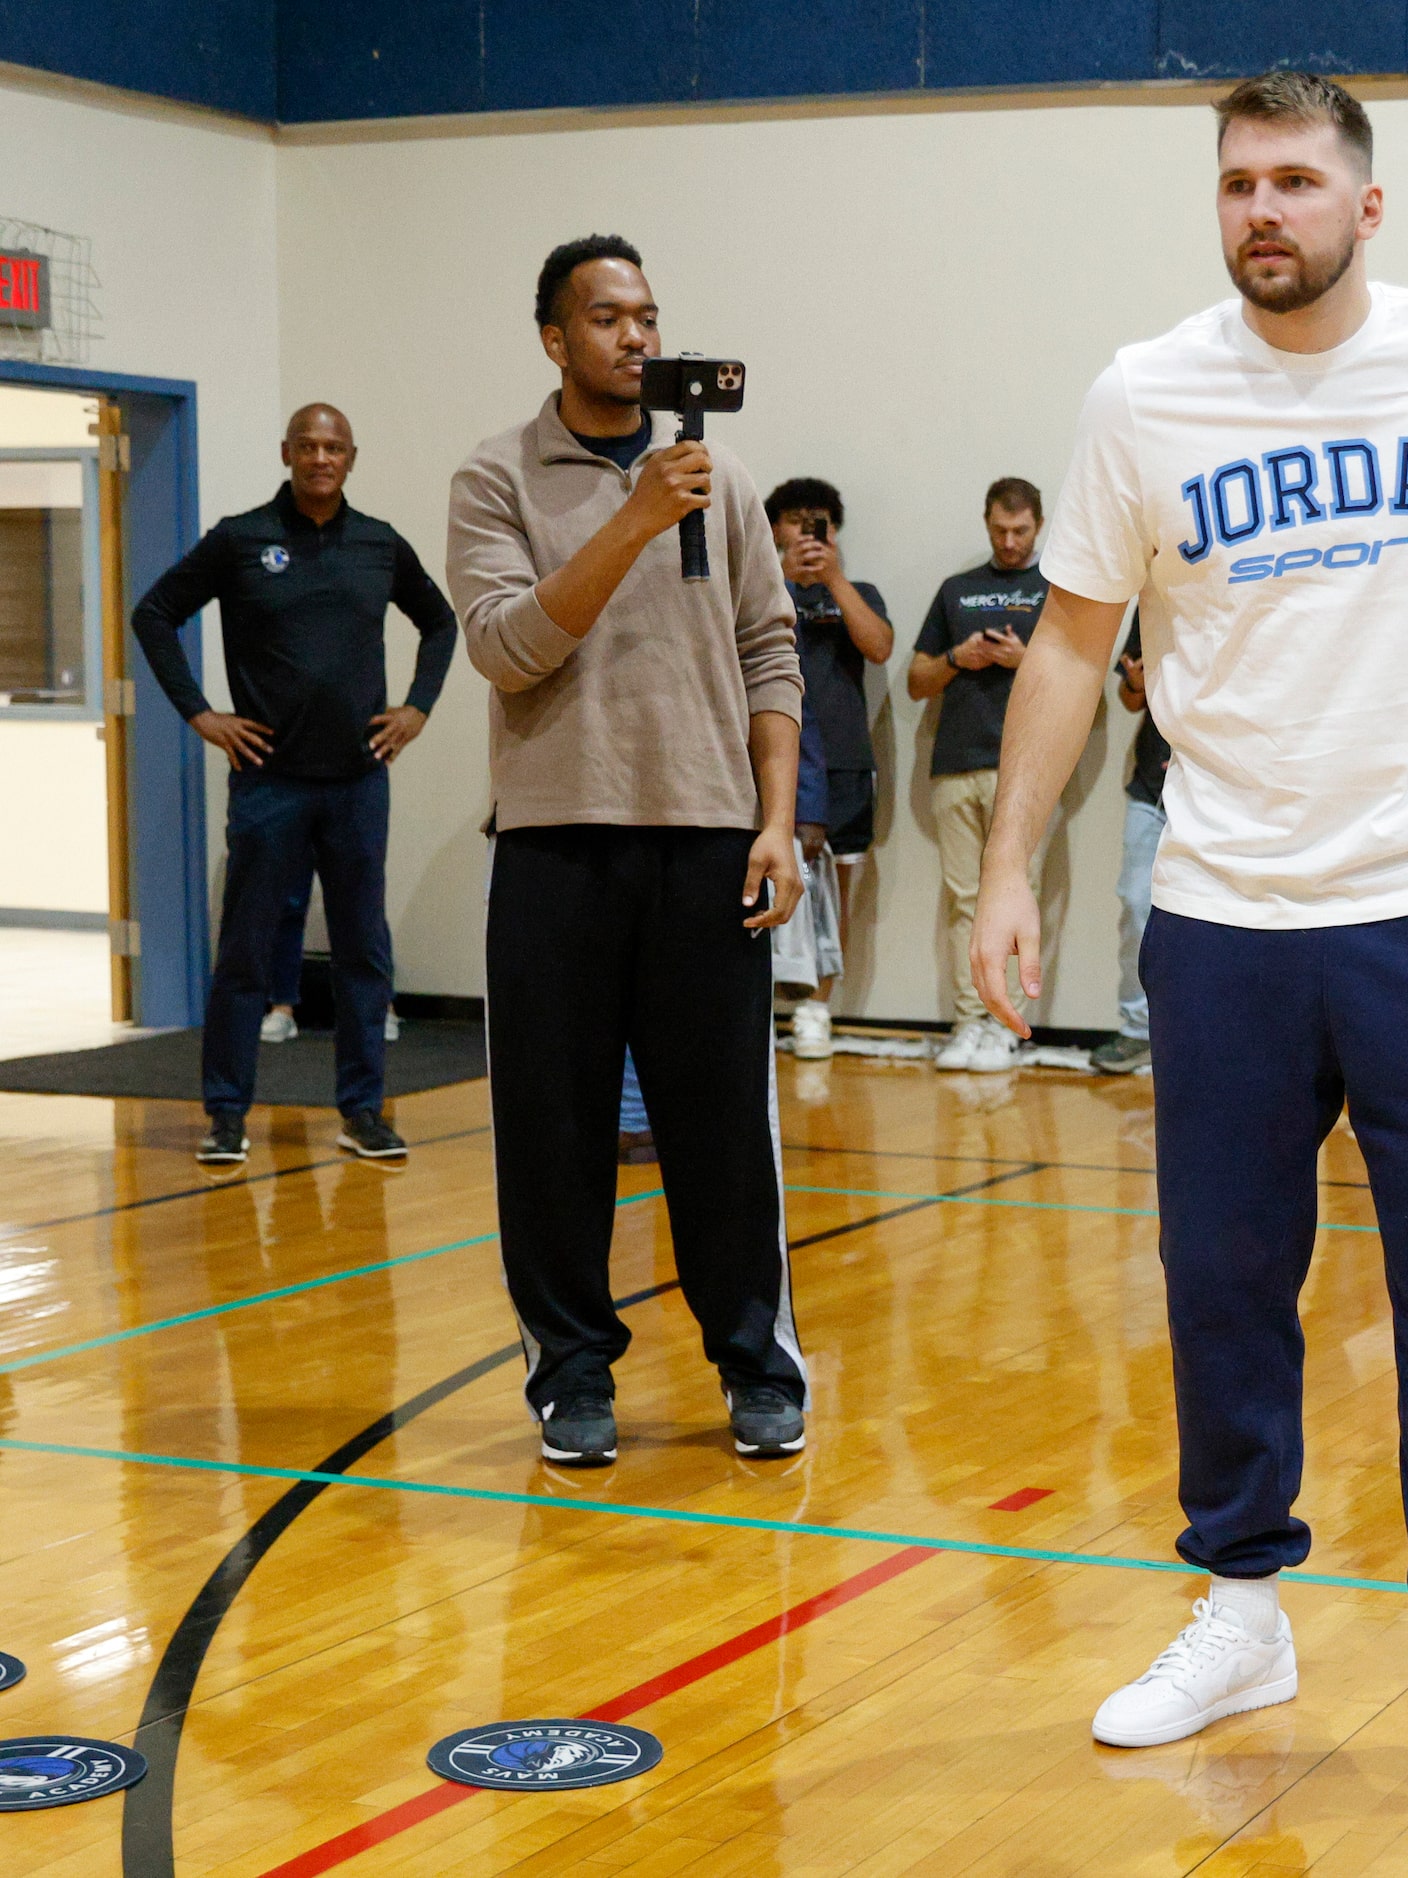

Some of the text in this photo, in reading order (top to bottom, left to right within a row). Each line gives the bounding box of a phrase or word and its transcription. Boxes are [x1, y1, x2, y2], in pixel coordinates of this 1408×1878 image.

[0, 255, 40, 314] EXIT
[506, 1729, 625, 1748] ACADEMY
[29, 1759, 113, 1799] ACADEMY
[481, 1767, 559, 1780] MAVS
